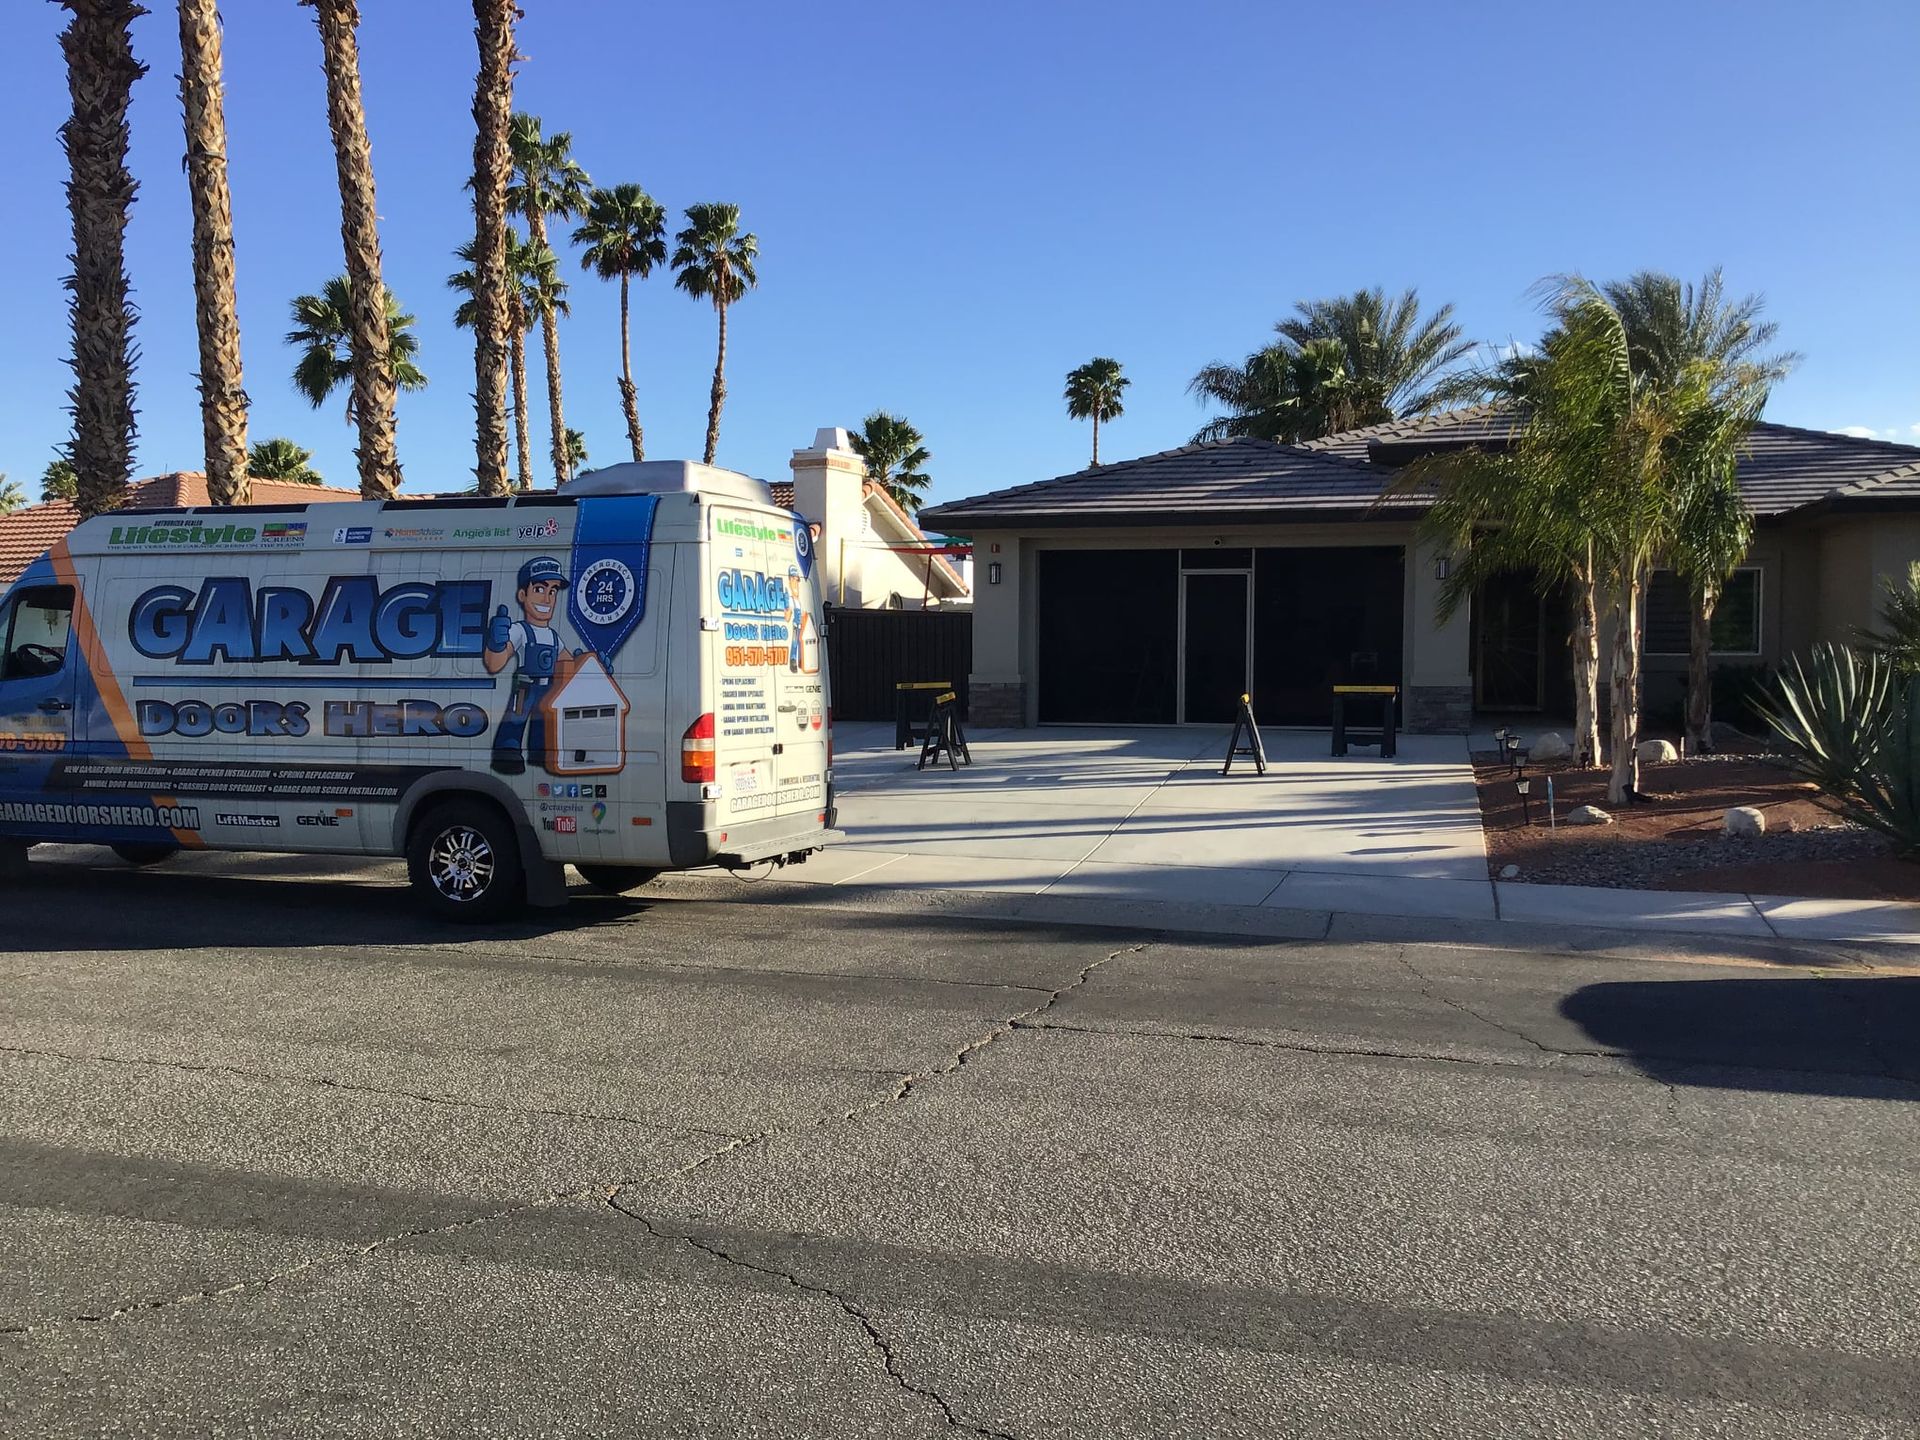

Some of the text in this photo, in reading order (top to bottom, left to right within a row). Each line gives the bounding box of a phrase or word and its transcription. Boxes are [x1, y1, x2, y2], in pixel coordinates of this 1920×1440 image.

[109, 525, 257, 546] Lifestyle
[394, 528, 445, 537] HomeAdvisor
[453, 528, 512, 540] Angie's list
[518, 525, 546, 542] yelp
[717, 518, 777, 541] Lifestyle
[583, 561, 632, 582] EMERGENCY
[597, 581, 614, 594] 24
[718, 569, 786, 614] GARAGE
[596, 595, 614, 603] HRS
[128, 576, 492, 665] GARAGE
[585, 606, 626, 622] SERVICE
[724, 623, 789, 641] DOORS HERO
[726, 646, 789, 667] 951-570-5707
[136, 700, 490, 738] DOORS HERO
[64, 766, 355, 781] NEW GARAGE DOOR INSTALLATION GARAGE OPENER INSTALLATION SPRING REPLACEMENT
[83, 780, 399, 796] ANNUAL DOOR MAINTENANCE CRASHED DOOR SPECIALIST GARAGE DOOR SCREEN INSTALLATION
[731, 785, 821, 813] GARAGEDOORSHERO.COM
[216, 815, 279, 828] LiftMaster
[296, 816, 340, 827] GENIE
[543, 817, 577, 832] YouTube
